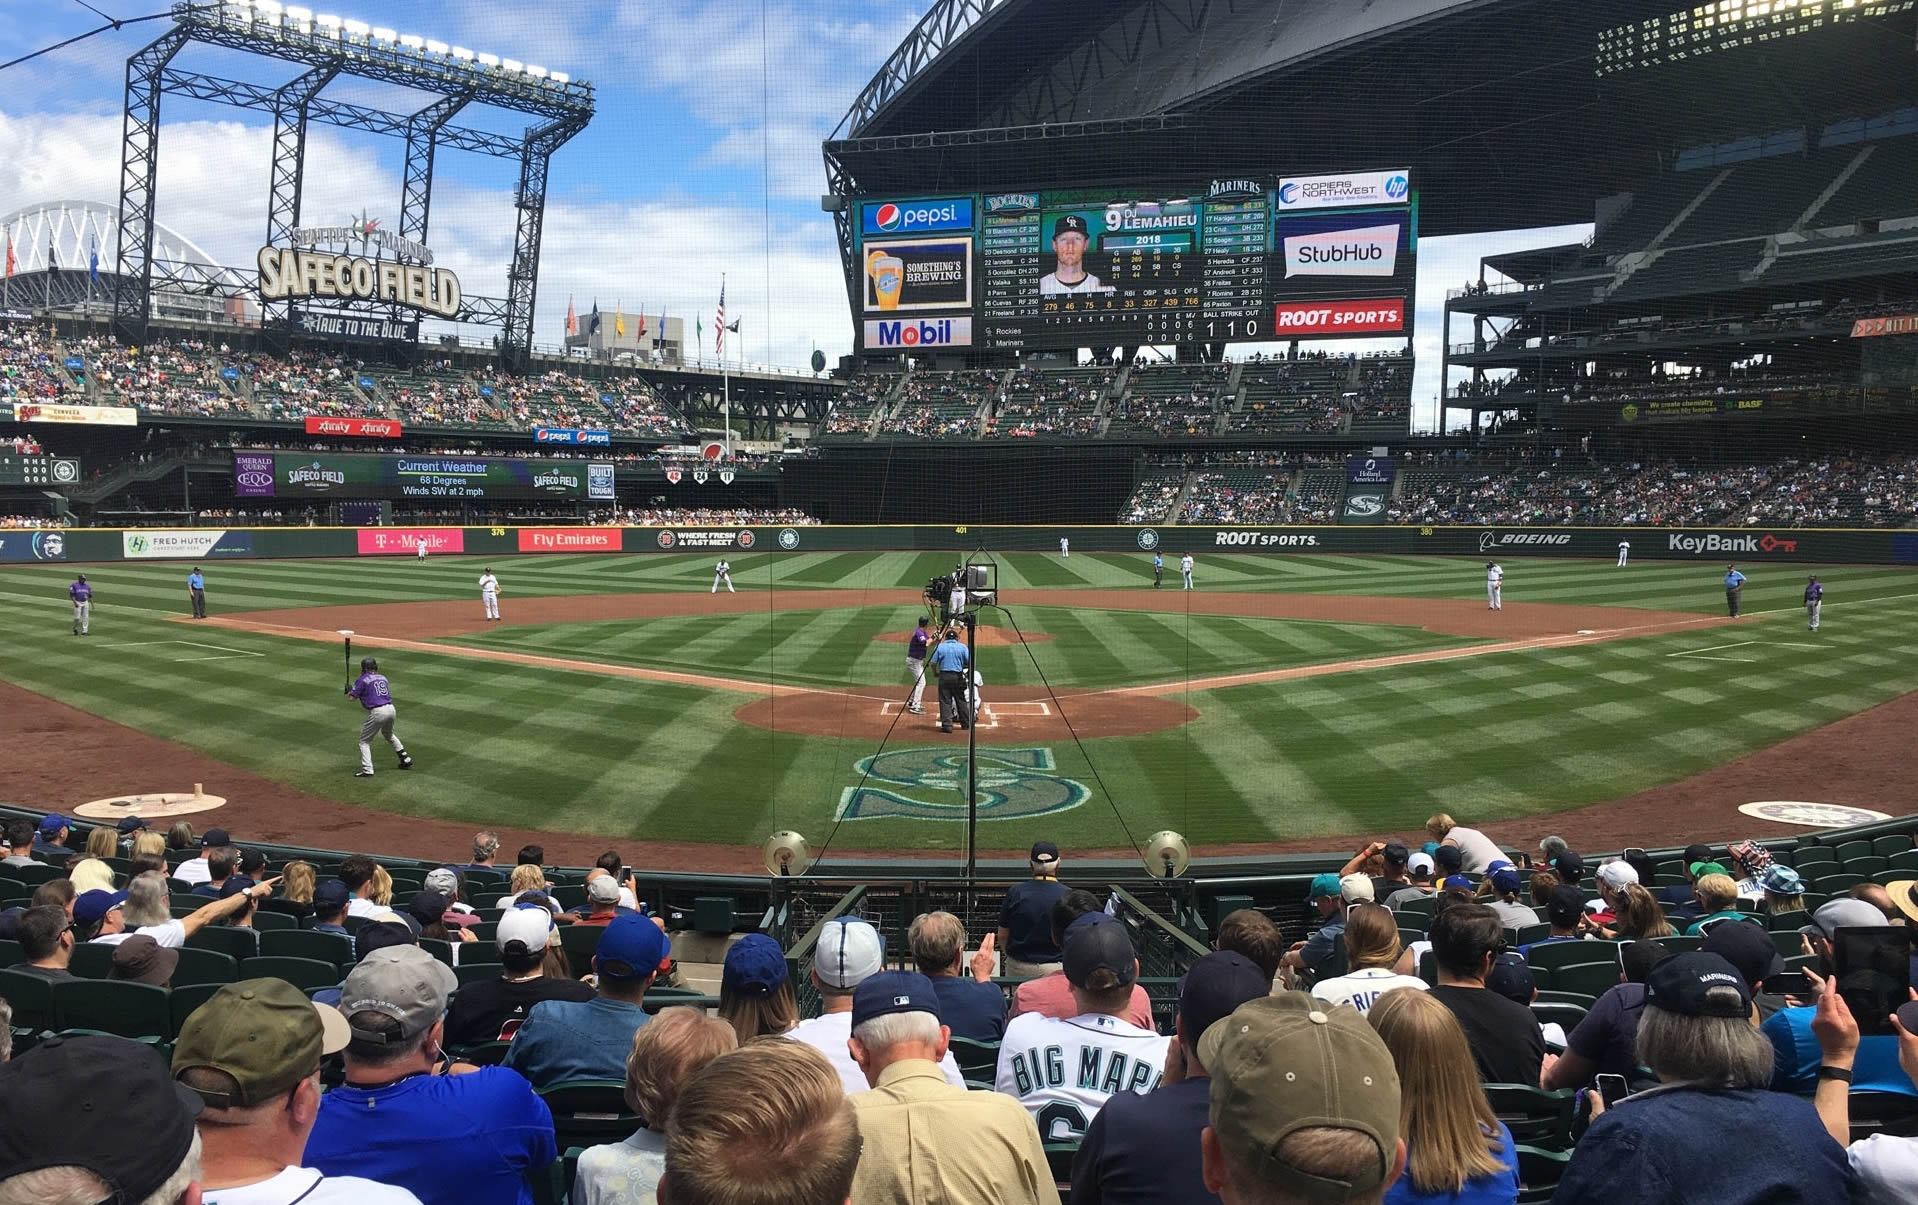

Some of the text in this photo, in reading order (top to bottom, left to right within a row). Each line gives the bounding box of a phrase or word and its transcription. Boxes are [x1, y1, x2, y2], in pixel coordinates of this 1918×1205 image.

[1210, 180, 1260, 196] MARINERS
[1303, 181, 1352, 190] COPIERS
[1387, 177, 1406, 198] hp
[1303, 187, 1376, 198] NORTHWEST
[904, 205, 956, 227] pepsi
[1106, 209, 1137, 231] 9 DJ
[1124, 215, 1197, 230] LEMAHIEU
[292, 227, 434, 265] SEATTLE MARINERS
[1136, 235, 1161, 244] 2018
[1299, 244, 1382, 263] StubHub
[907, 261, 961, 273] SOMETHING'S
[259, 246, 461, 319] SAFECO FIELD
[907, 271, 961, 282] BREWING
[1280, 310, 1397, 326] ROOT SPORTS
[315, 315, 408, 339] TRUE TO THE BLUE
[1148, 322, 1153, 330] 0
[1207, 320, 1257, 336] 1 1 0
[1886, 319, 1904, 332] HIT
[879, 320, 950, 345] Mobil
[1175, 333, 1180, 341] 0
[1738, 400, 1763, 409] BASF
[318, 422, 391, 435] xfinity xfinity
[549, 433, 609, 443] pepsi pepsi
[398, 460, 487, 472] Current Weather
[590, 468, 611, 477] BUILT
[241, 472, 272, 487] EQC
[289, 470, 344, 484] SAFECO FIELD
[420, 476, 466, 486] 68 Degrees
[534, 476, 578, 488] SAFECO FIELD
[403, 486, 429, 495] Winds
[431, 487, 447, 495] SW
[459, 487, 464, 495] 2
[466, 488, 483, 497] mph
[1421, 527, 1432, 536] 380
[401, 534, 442, 548] Moile
[534, 534, 608, 547] Fly Emirates
[1215, 532, 1316, 545] ROOT SPORTS
[1500, 534, 1571, 544] BOEING
[1669, 534, 1758, 554] KeyBank
[374, 680, 388, 696] 19
[1699, 973, 1737, 983] MARINERS
[1011, 1045, 1165, 1097] BIG MAP
